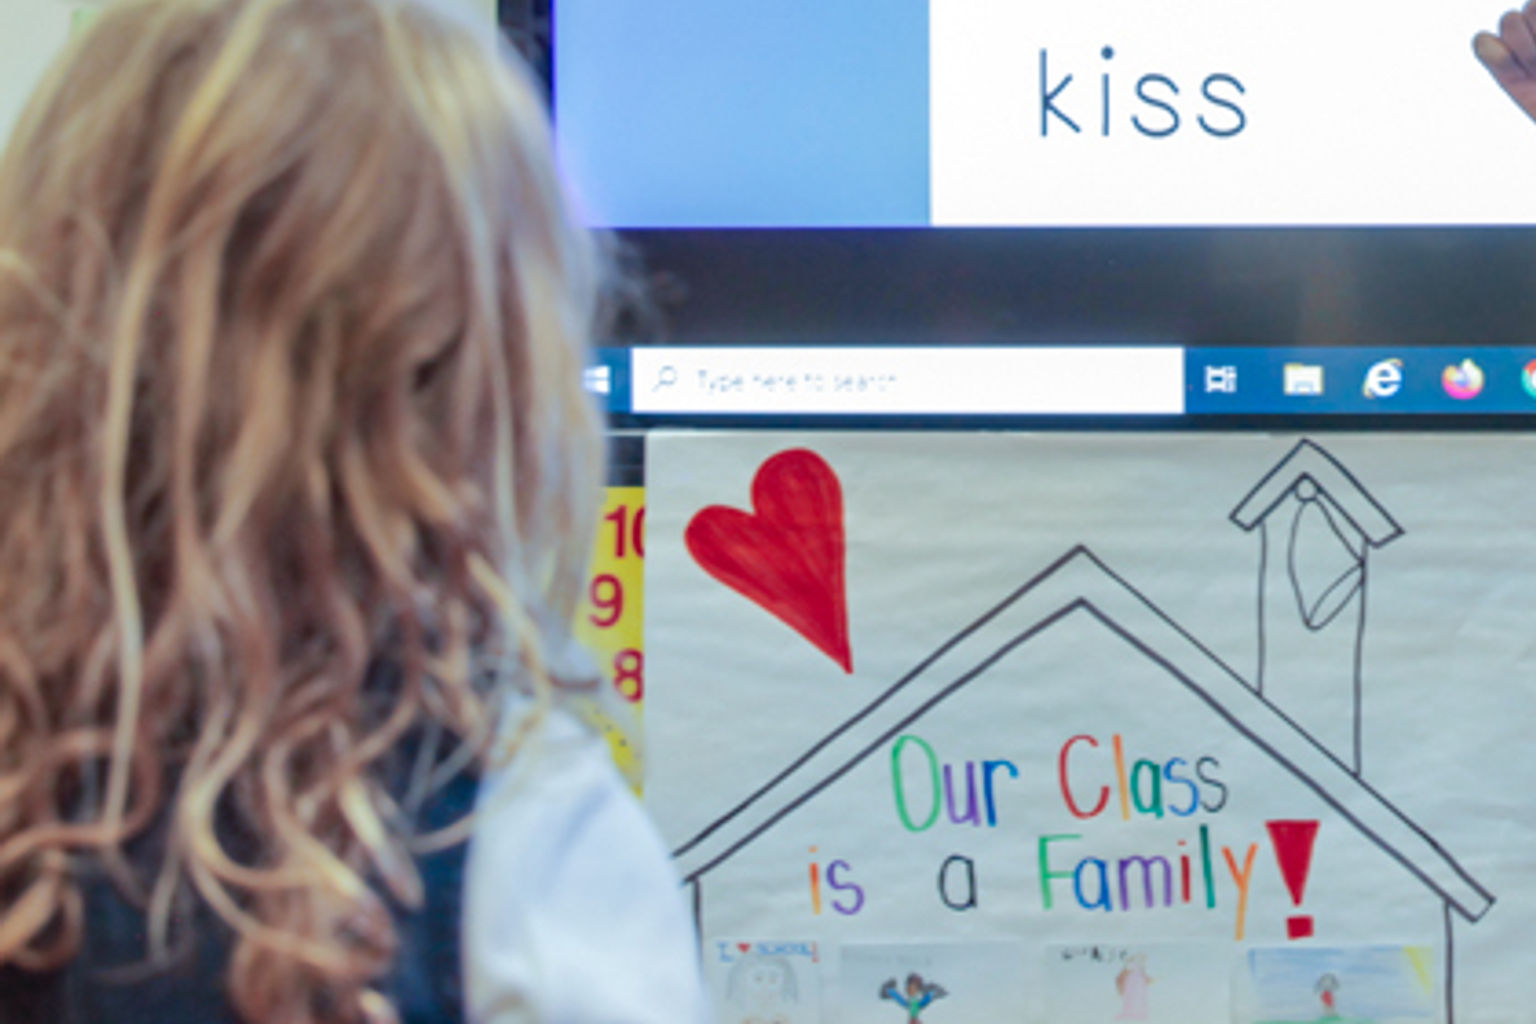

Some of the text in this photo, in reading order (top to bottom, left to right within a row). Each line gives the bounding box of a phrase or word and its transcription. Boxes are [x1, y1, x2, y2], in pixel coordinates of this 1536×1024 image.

[1040, 44, 1247, 138] kiss
[588, 572, 624, 629] 9
[612, 647, 645, 703] 8
[892, 733, 1229, 833] Our Class
[808, 819, 1321, 941] is a Family!
